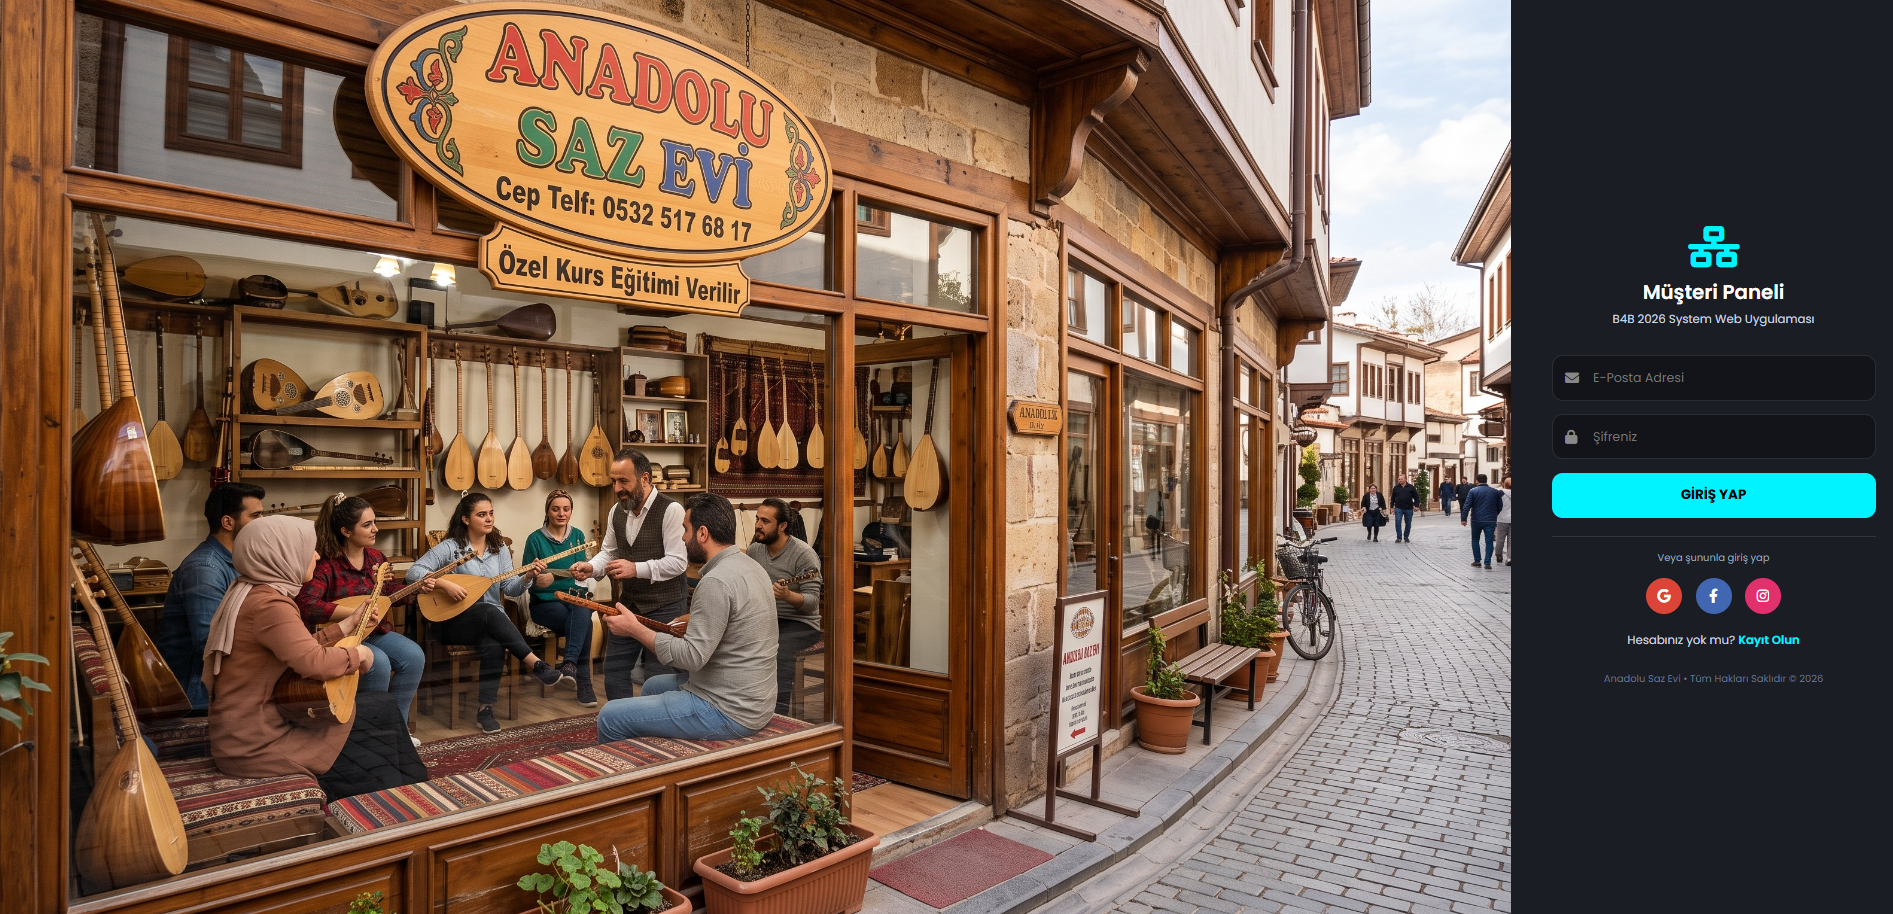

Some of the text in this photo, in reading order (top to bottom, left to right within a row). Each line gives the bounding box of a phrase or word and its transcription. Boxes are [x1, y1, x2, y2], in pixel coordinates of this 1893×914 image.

[486, 22, 773, 148] ANADOLU
[516, 106, 753, 210] SAZ EVİ
[496, 176, 752, 243] Cep Telf: 0532 517 68 17
[499, 244, 741, 305] Özel Kurs Eğitimi Verilir
[1643, 283, 1784, 305] Müşteri Paneli
[1612, 314, 1815, 327] B4B 2026 System Web Uygulaması
[1593, 372, 1685, 383] E-Posta Adresi
[1593, 431, 1638, 445] Şifreniz
[1681, 486, 1747, 504] GİRİŞ YAP
[1657, 553, 1770, 565] Veya şununla giriş yap
[1627, 635, 1800, 648] Hesabınız yok mu? Kayıt Olun
[1604, 674, 1646, 683] Anadolu
[1648, 674, 1666, 683] Saz
[1668, 674, 1681, 683] Evi
[1690, 674, 1712, 683] Tüm
[1715, 674, 1749, 683] Hakları
[1751, 674, 1787, 683] Saklıdır
[1799, 674, 1824, 683] 2026
